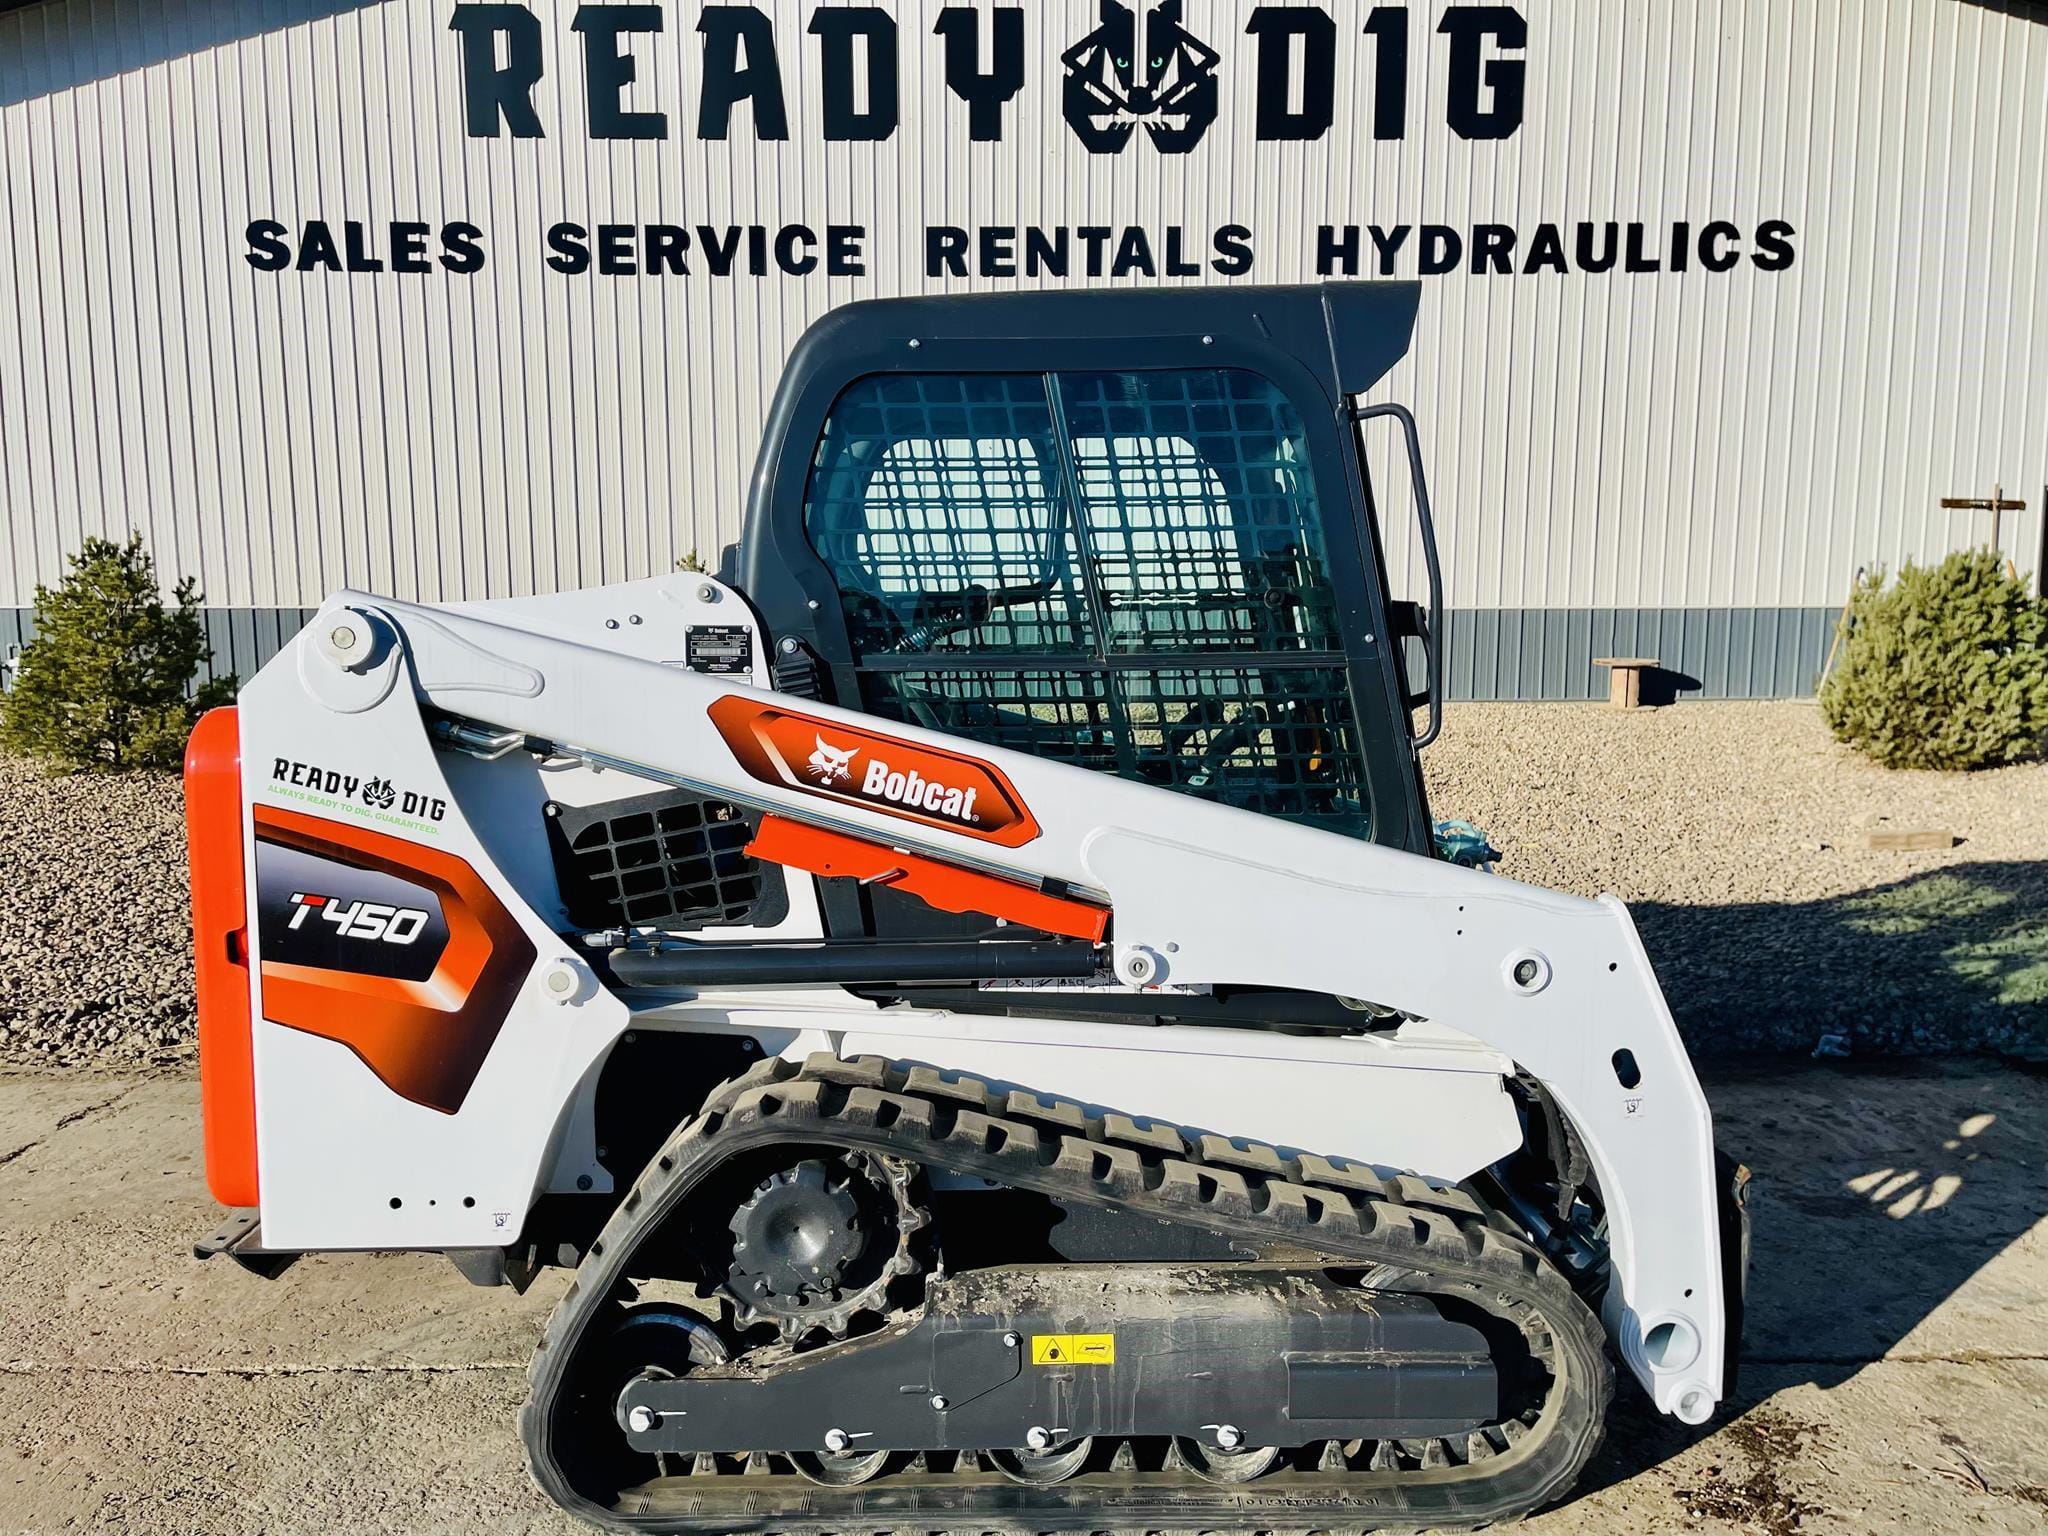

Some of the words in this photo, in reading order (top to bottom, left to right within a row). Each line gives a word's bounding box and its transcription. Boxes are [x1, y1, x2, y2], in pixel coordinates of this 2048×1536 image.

[449, 3, 1024, 140] READY
[1245, 6, 1527, 141] DIG
[245, 219, 484, 273] SALES
[547, 222, 865, 277] SERVICE
[927, 224, 1253, 277] RENTALS
[1317, 219, 1796, 275] HYDRAULICS
[268, 784, 306, 801] ALWAYS
[307, 794, 339, 810] READY
[341, 803, 353, 813] TO
[355, 807, 373, 819] DIG.
[375, 812, 440, 836] GUARANTEED.
[272, 757, 359, 798] READY
[401, 791, 446, 822] DIG
[287, 893, 430, 945] T450
